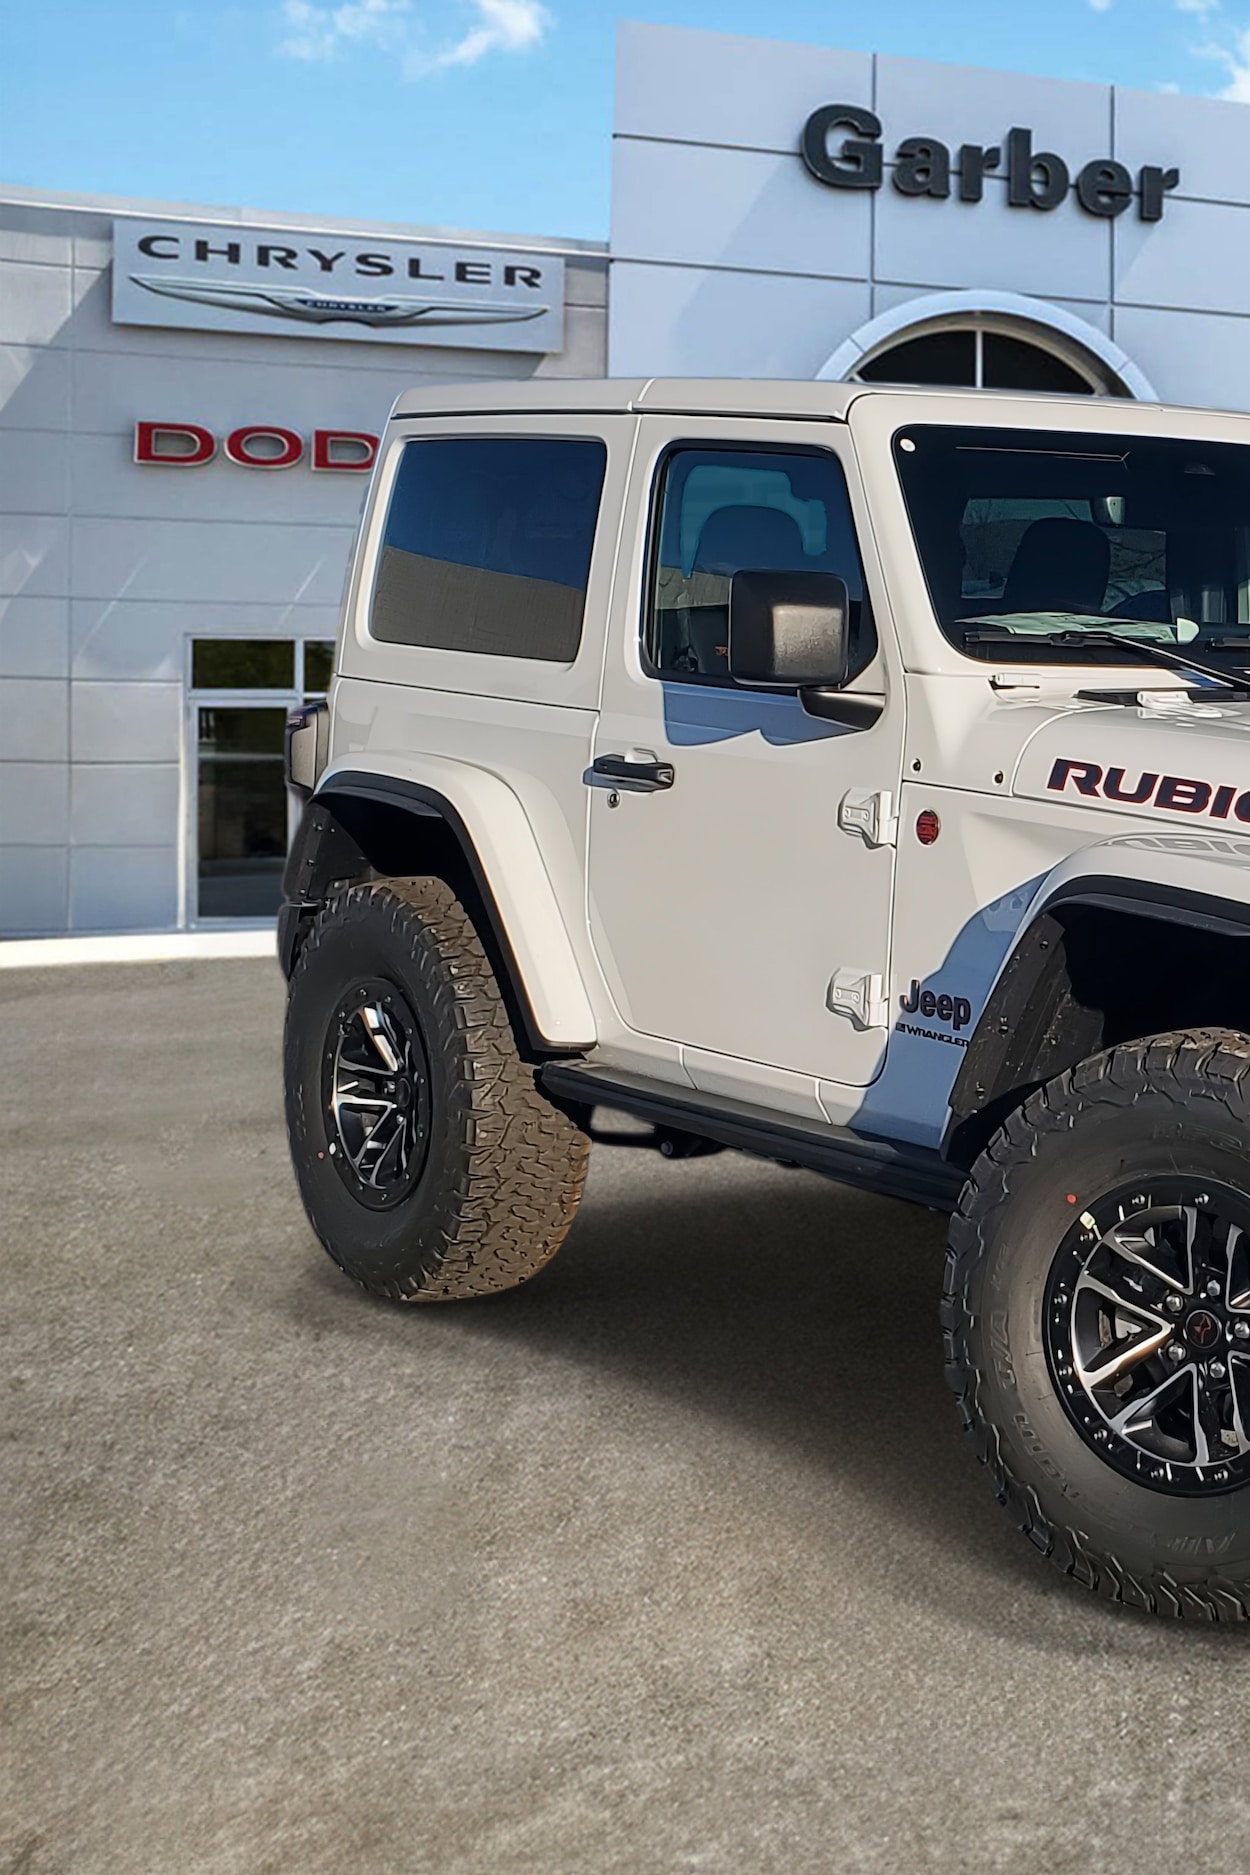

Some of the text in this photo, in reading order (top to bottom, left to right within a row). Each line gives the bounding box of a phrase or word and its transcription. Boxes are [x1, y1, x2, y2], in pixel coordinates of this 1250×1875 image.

[801, 103, 1180, 222] Garber
[138, 235, 542, 288] CHRYSLER
[899, 979, 971, 1031] Jeep
[905, 1024, 970, 1048] WRANGLER
